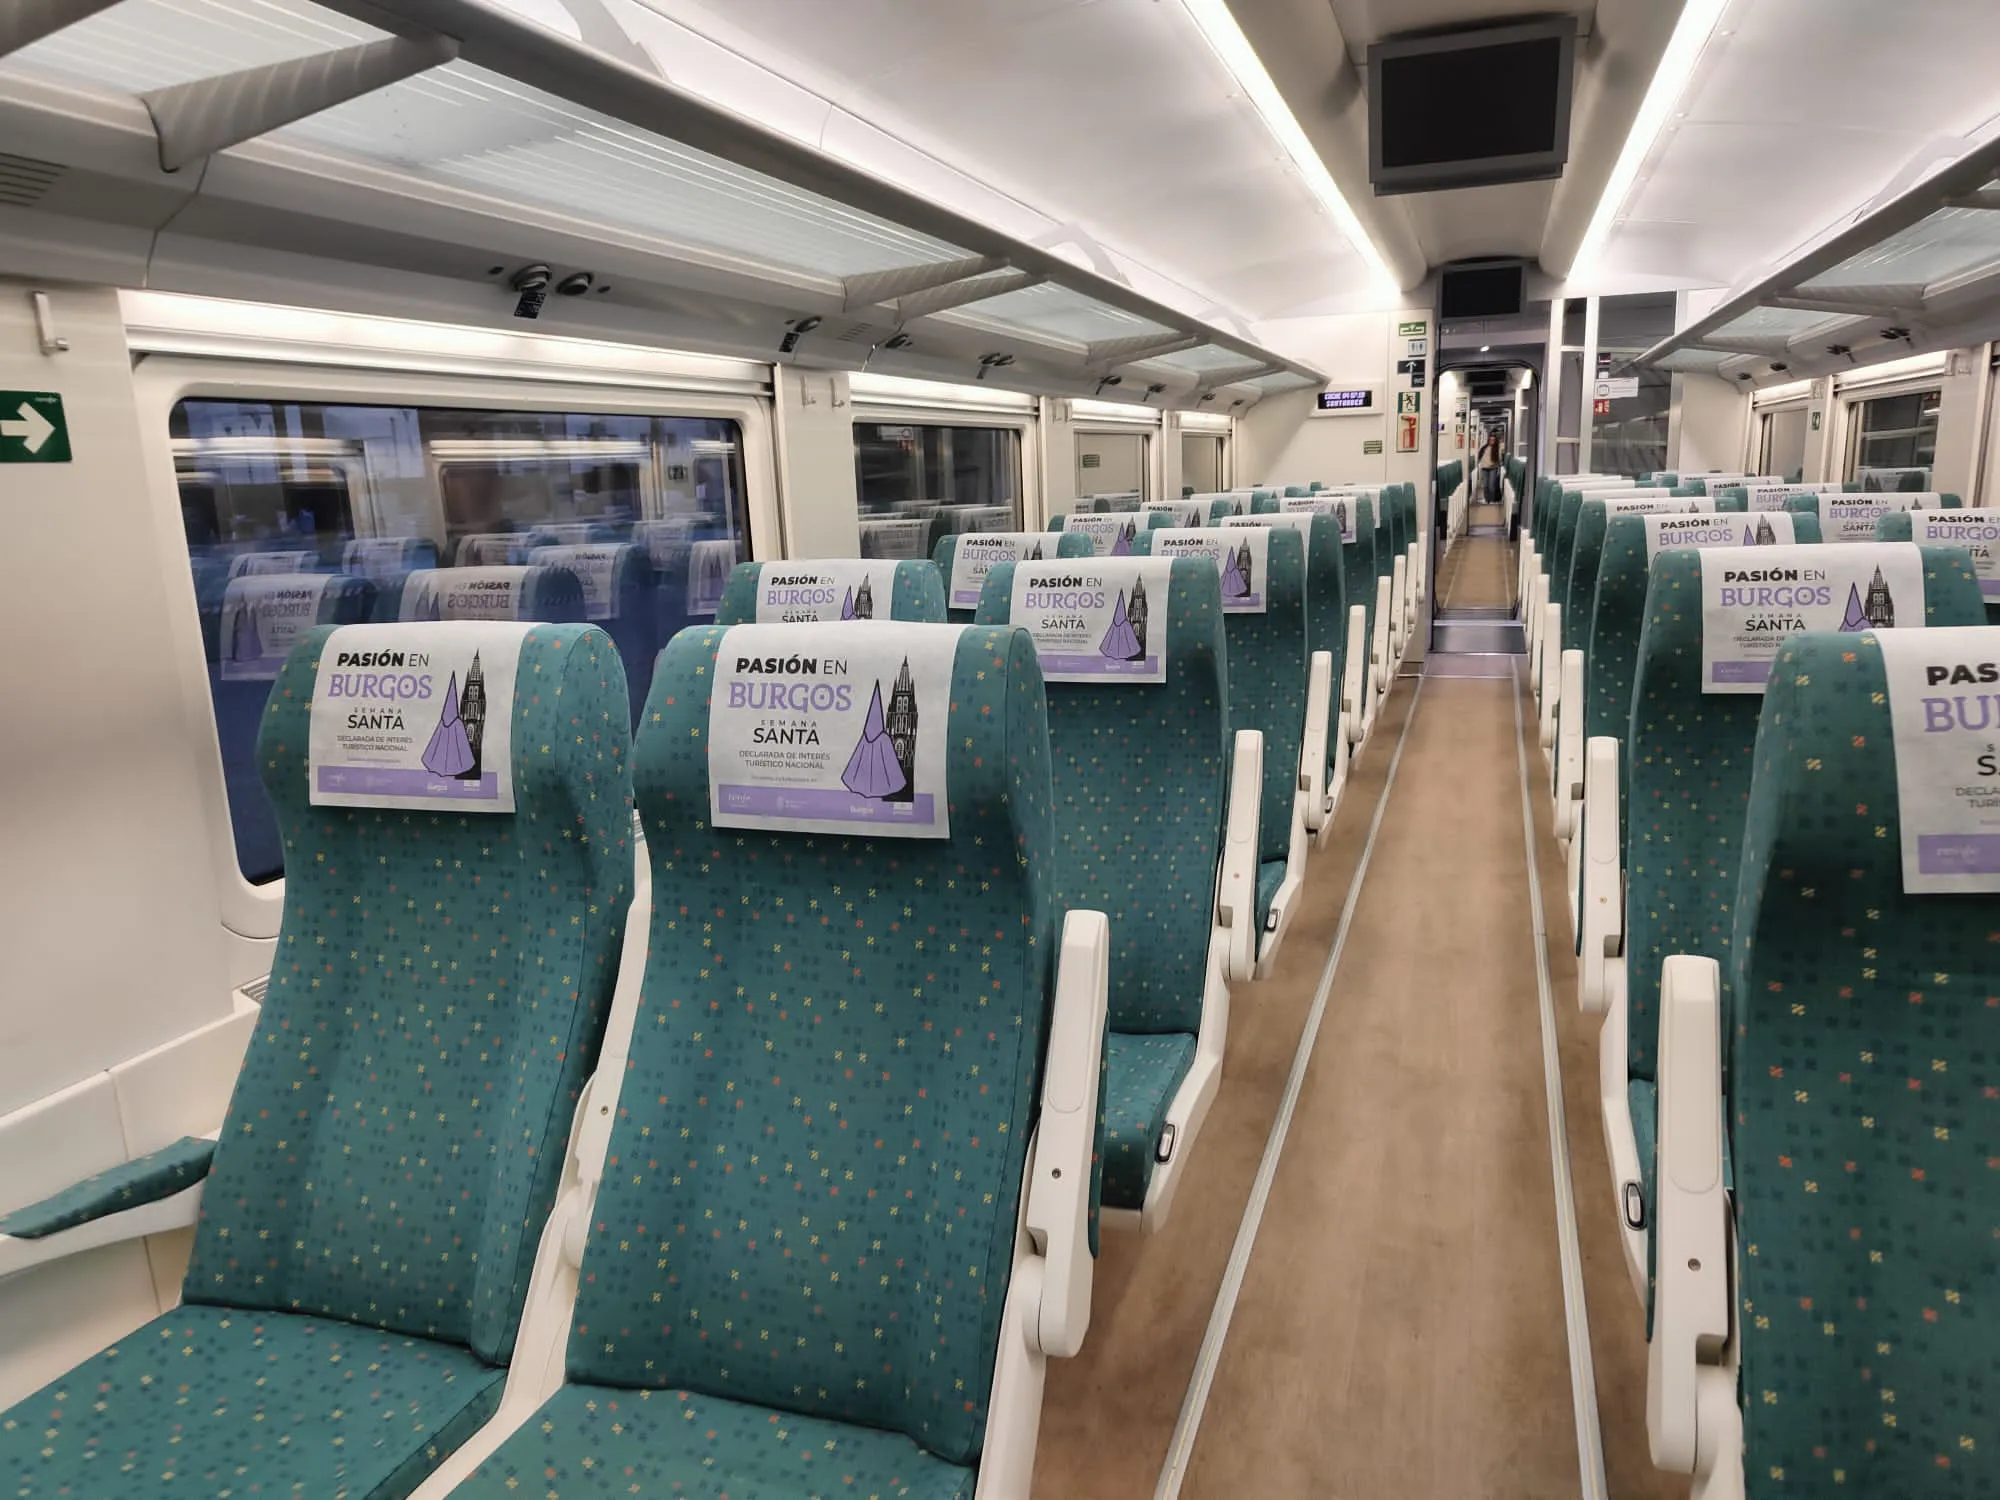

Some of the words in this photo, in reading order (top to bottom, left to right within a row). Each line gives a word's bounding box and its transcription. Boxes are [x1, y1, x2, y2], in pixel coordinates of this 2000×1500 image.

[1660, 518, 1710, 529] PASIÓN
[1713, 519, 1728, 527] EN
[1928, 514, 1984, 524] PASIÓN
[1658, 529, 1733, 546] BURGOS
[1926, 526, 2000, 541] BURGO
[966, 537, 1002, 547] PASIÓN
[1164, 538, 1203, 546] PASIÓN
[962, 548, 1016, 561] BURGOS
[771, 574, 817, 585] PASIÓN
[820, 577, 835, 585] EN
[1030, 575, 1082, 588] PASIÓN
[1086, 577, 1102, 586] EN
[1724, 567, 1798, 582] PASIÓN
[1804, 570, 1826, 581] EN
[767, 588, 835, 606] BURGOS
[1025, 592, 1105, 610] BURGOS
[1720, 586, 1831, 608] BURGOS
[1041, 619, 1085, 630] SANTA
[1745, 619, 1806, 632] SANTA
[337, 649, 405, 667] PASIÓN
[408, 653, 430, 667] EN
[735, 654, 818, 675] PASIÓN
[824, 659, 848, 675] EN
[328, 673, 432, 701] BURGOS
[728, 681, 852, 713] BURGOS
[1920, 694, 2000, 732] BU
[347, 715, 405, 731] SANTA
[761, 719, 817, 727] SEMANA
[753, 728, 820, 745] SANTA
[739, 750, 784, 759] DECLARADA
[786, 752, 797, 760] DE
[798, 751, 831, 761] INTERÉS
[785, 761, 825, 769] NACIONAL
